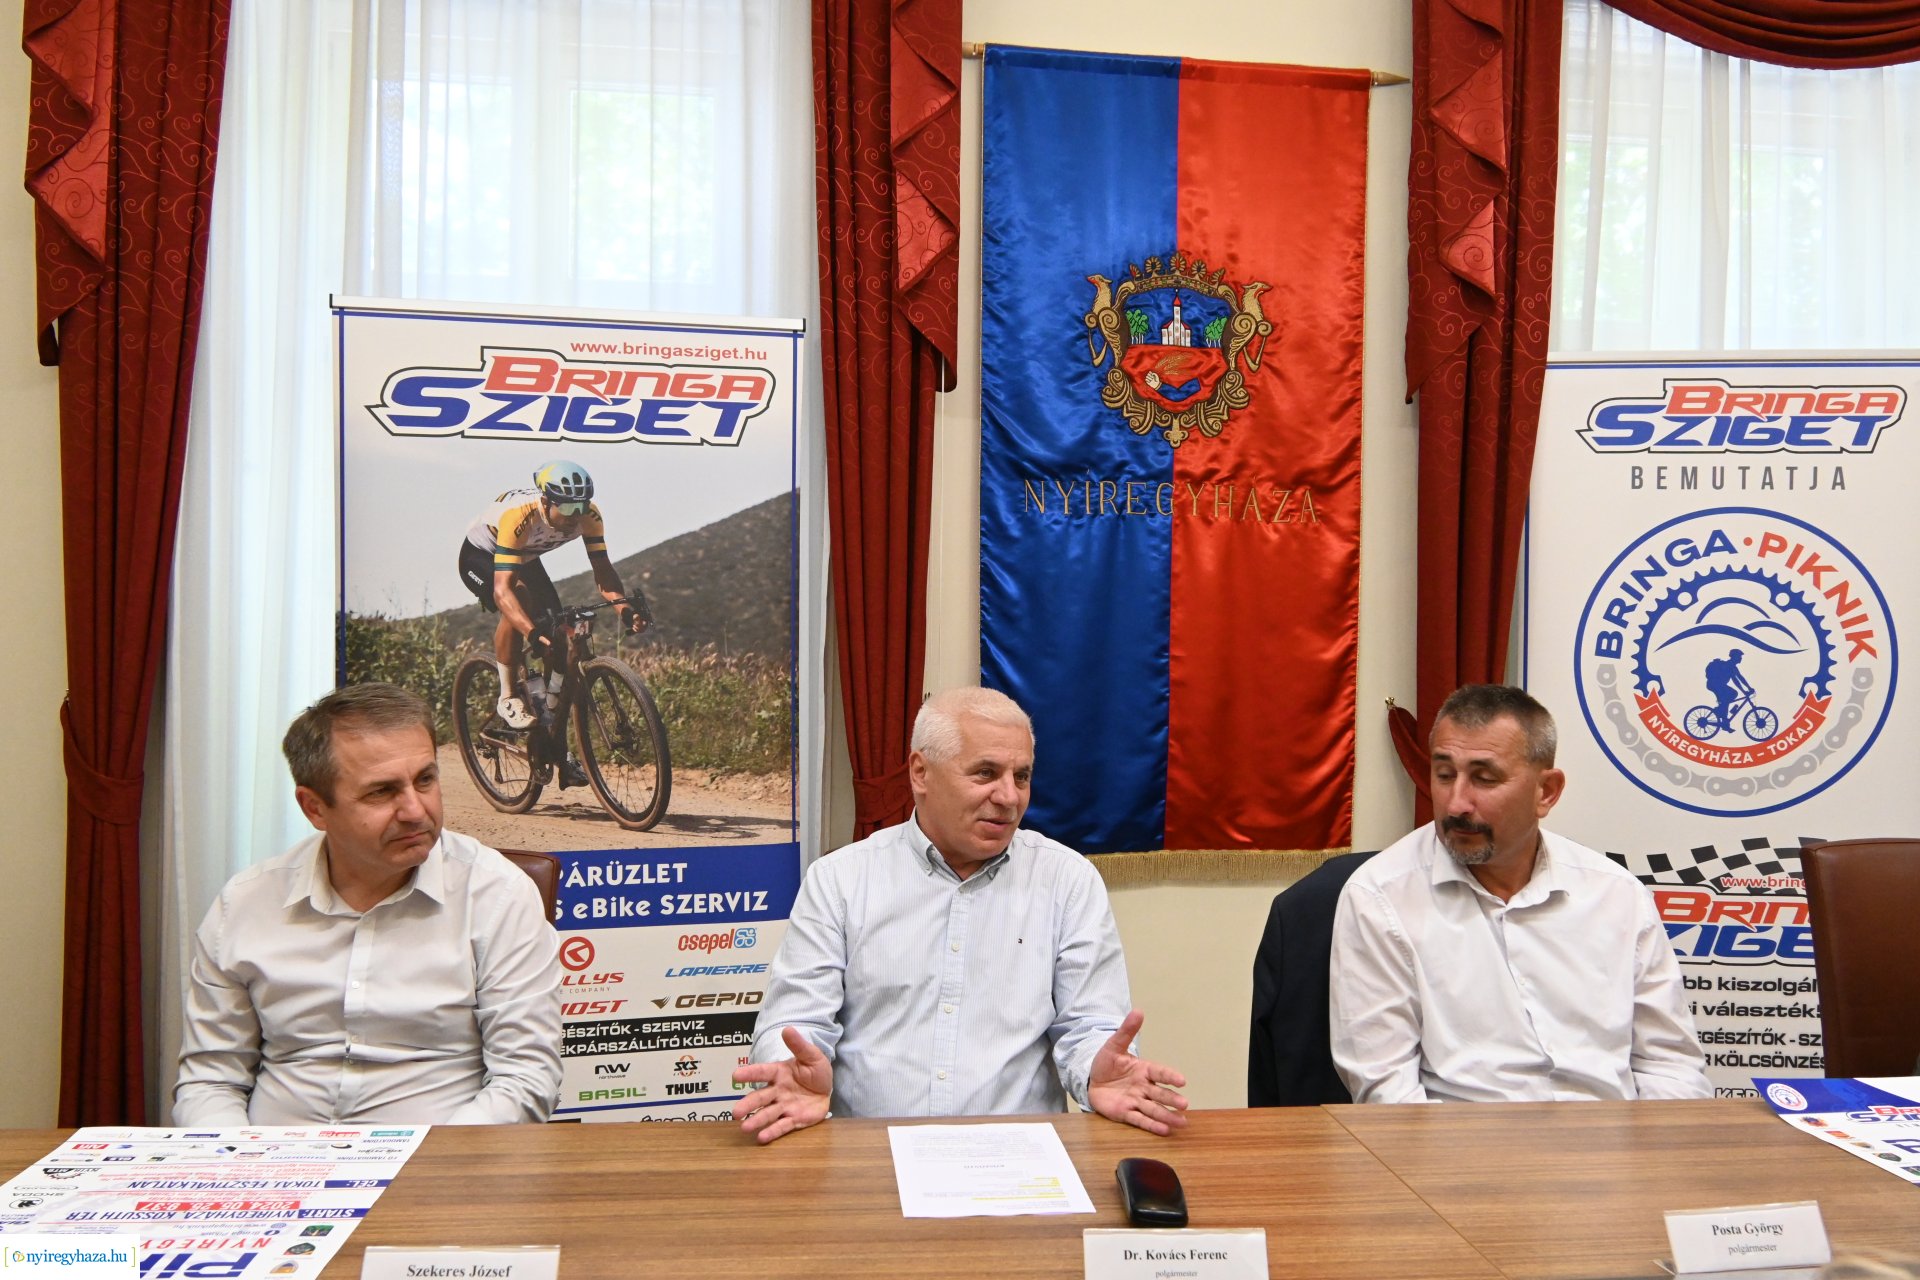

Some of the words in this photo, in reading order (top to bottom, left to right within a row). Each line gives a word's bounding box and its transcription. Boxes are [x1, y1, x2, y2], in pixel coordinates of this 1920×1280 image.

[570, 341, 767, 361] www.bringasziget.hu
[386, 376, 759, 438] SZIGET
[1591, 405, 1893, 447] SZIGET
[1631, 465, 1846, 491] BEMUTATJA
[1023, 468, 1319, 524] NYÍREGYHÁZA
[1594, 529, 1739, 660] BRINGA
[1757, 531, 1878, 664] PIKNIK
[1648, 715, 1754, 764] NYÍREGYHÁZA
[1766, 719, 1815, 756] TOKAJ
[572, 896, 651, 920] eBike
[660, 890, 769, 915] SZERVIZ
[1652, 890, 1811, 931] BRIN
[678, 928, 735, 954] csepel
[665, 963, 769, 978] LAPIERRE
[560, 972, 625, 986] LLYS
[1718, 976, 1817, 996] kiszolgál
[569, 986, 611, 994] COMPANY
[642, 1020, 705, 1033] SZERVIZ
[578, 1087, 646, 1102] BASIL
[665, 1081, 709, 1096] THULE
[127, 1180, 269, 1191] FESZTIVÁLKATLAN
[65, 1211, 98, 1221] TÉR
[100, 1211, 177, 1220] KOSSUTH
[183, 1210, 297, 1220] NYÍREGYHÁZA,
[302, 1209, 355, 1218] START:
[1712, 1223, 1742, 1236] Posta
[1745, 1223, 1785, 1236] György
[1124, 1249, 1142, 1261] Dr.
[1146, 1249, 1186, 1261] Kovács
[1190, 1249, 1228, 1261] Ferenc
[1728, 1243, 1778, 1255] polgármester
[406, 1264, 466, 1278] Szekeres
[469, 1264, 513, 1278] József
[1155, 1269, 1198, 1278] polgármester
